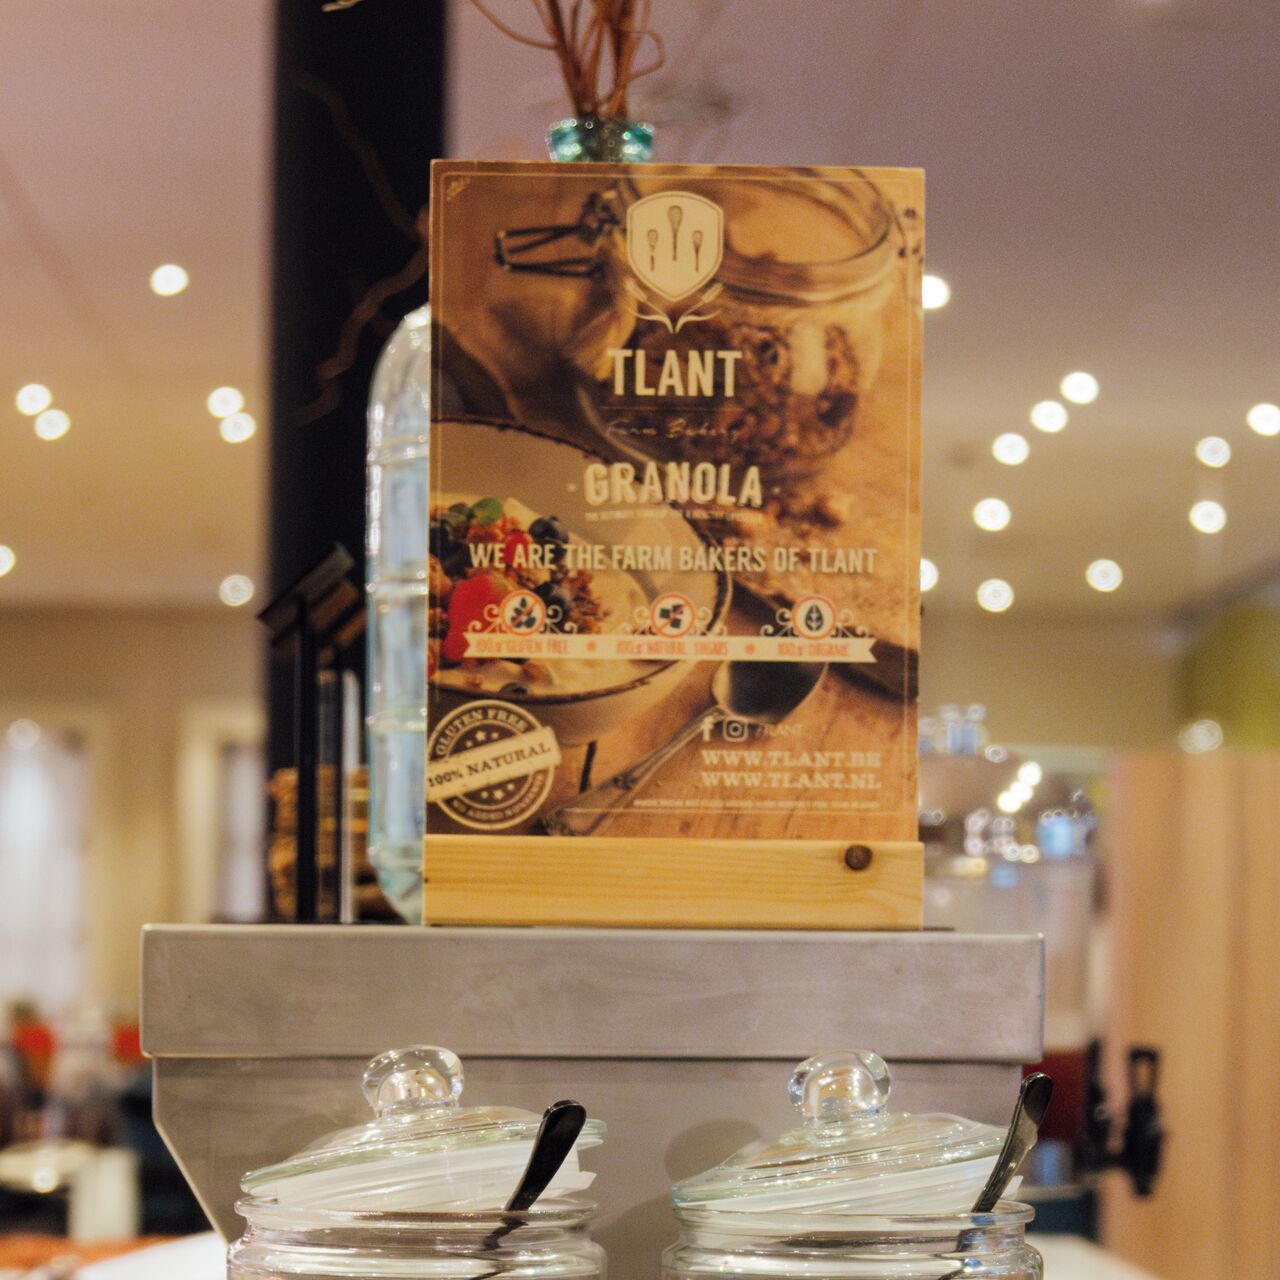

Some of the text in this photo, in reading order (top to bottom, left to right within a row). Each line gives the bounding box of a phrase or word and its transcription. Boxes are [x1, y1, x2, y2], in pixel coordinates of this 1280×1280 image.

[609, 349, 742, 397] TLANT
[583, 461, 763, 507] GRANOLA
[469, 543, 878, 574] WE ARE THE FARM BAKERS OF TLANT
[435, 708, 528, 756] GLUTEN FREE
[427, 743, 551, 788] 100% NATURAL
[700, 749, 881, 768] WWW.TLANT.BE
[700, 771, 882, 789] WWW.TLANT.NL
